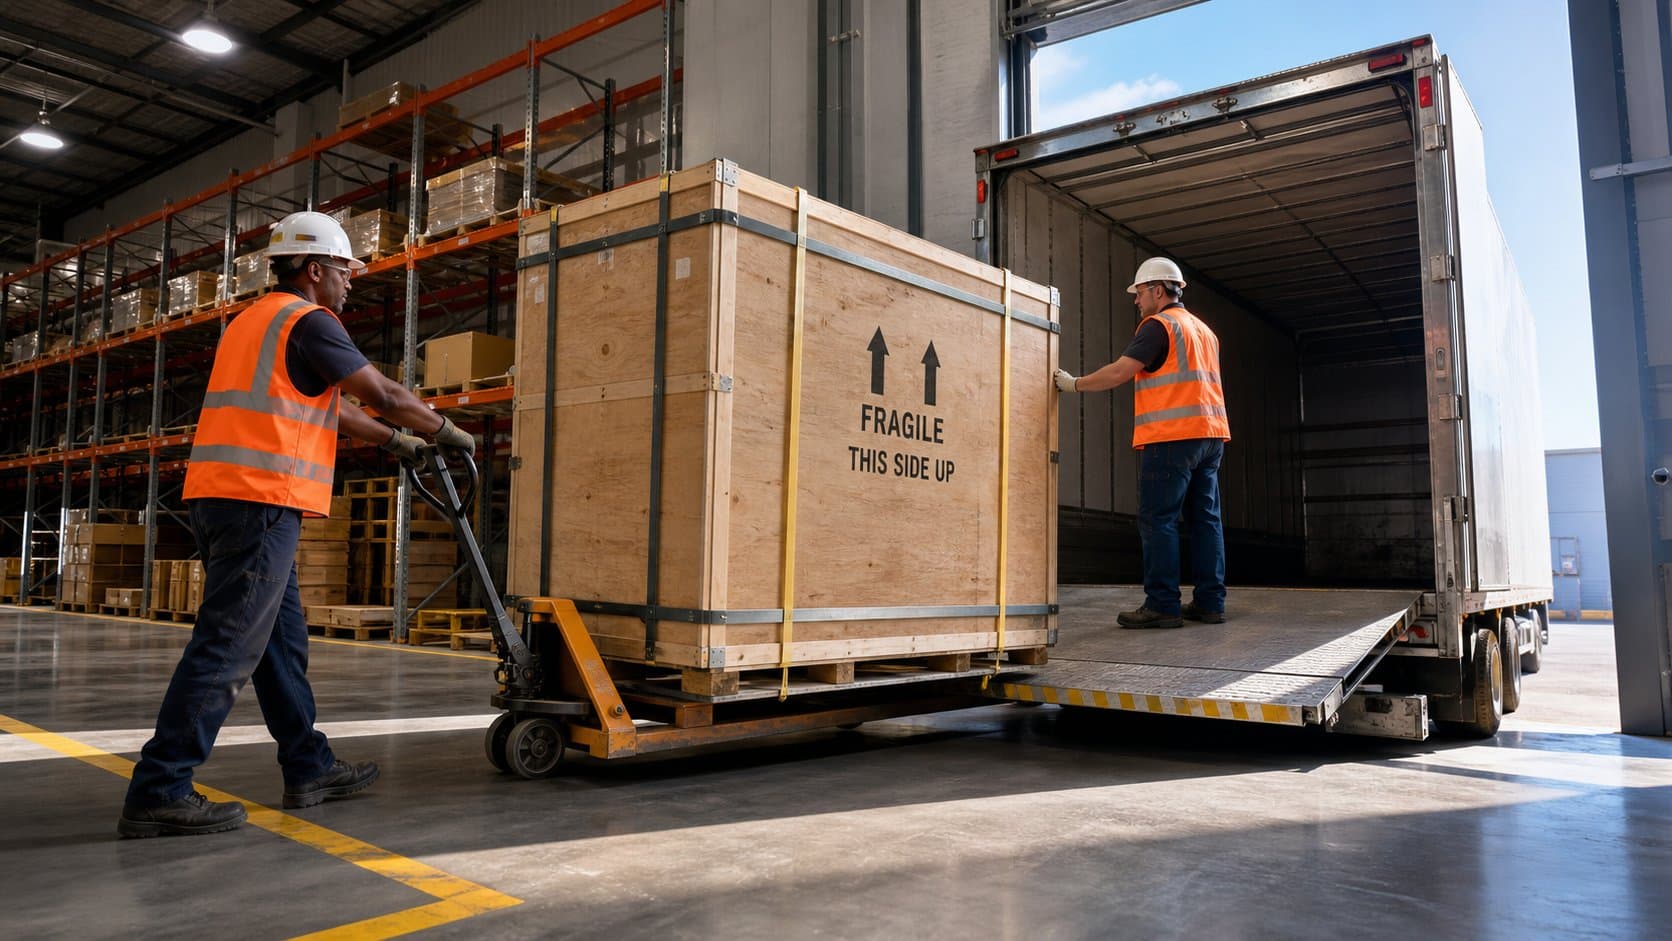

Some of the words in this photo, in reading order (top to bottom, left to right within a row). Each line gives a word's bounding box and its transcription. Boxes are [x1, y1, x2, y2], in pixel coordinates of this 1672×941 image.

[861, 404, 944, 444] FRAGILE
[848, 446, 888, 475] THIS
[893, 453, 930, 480] SIDE
[935, 459, 955, 483] UP
